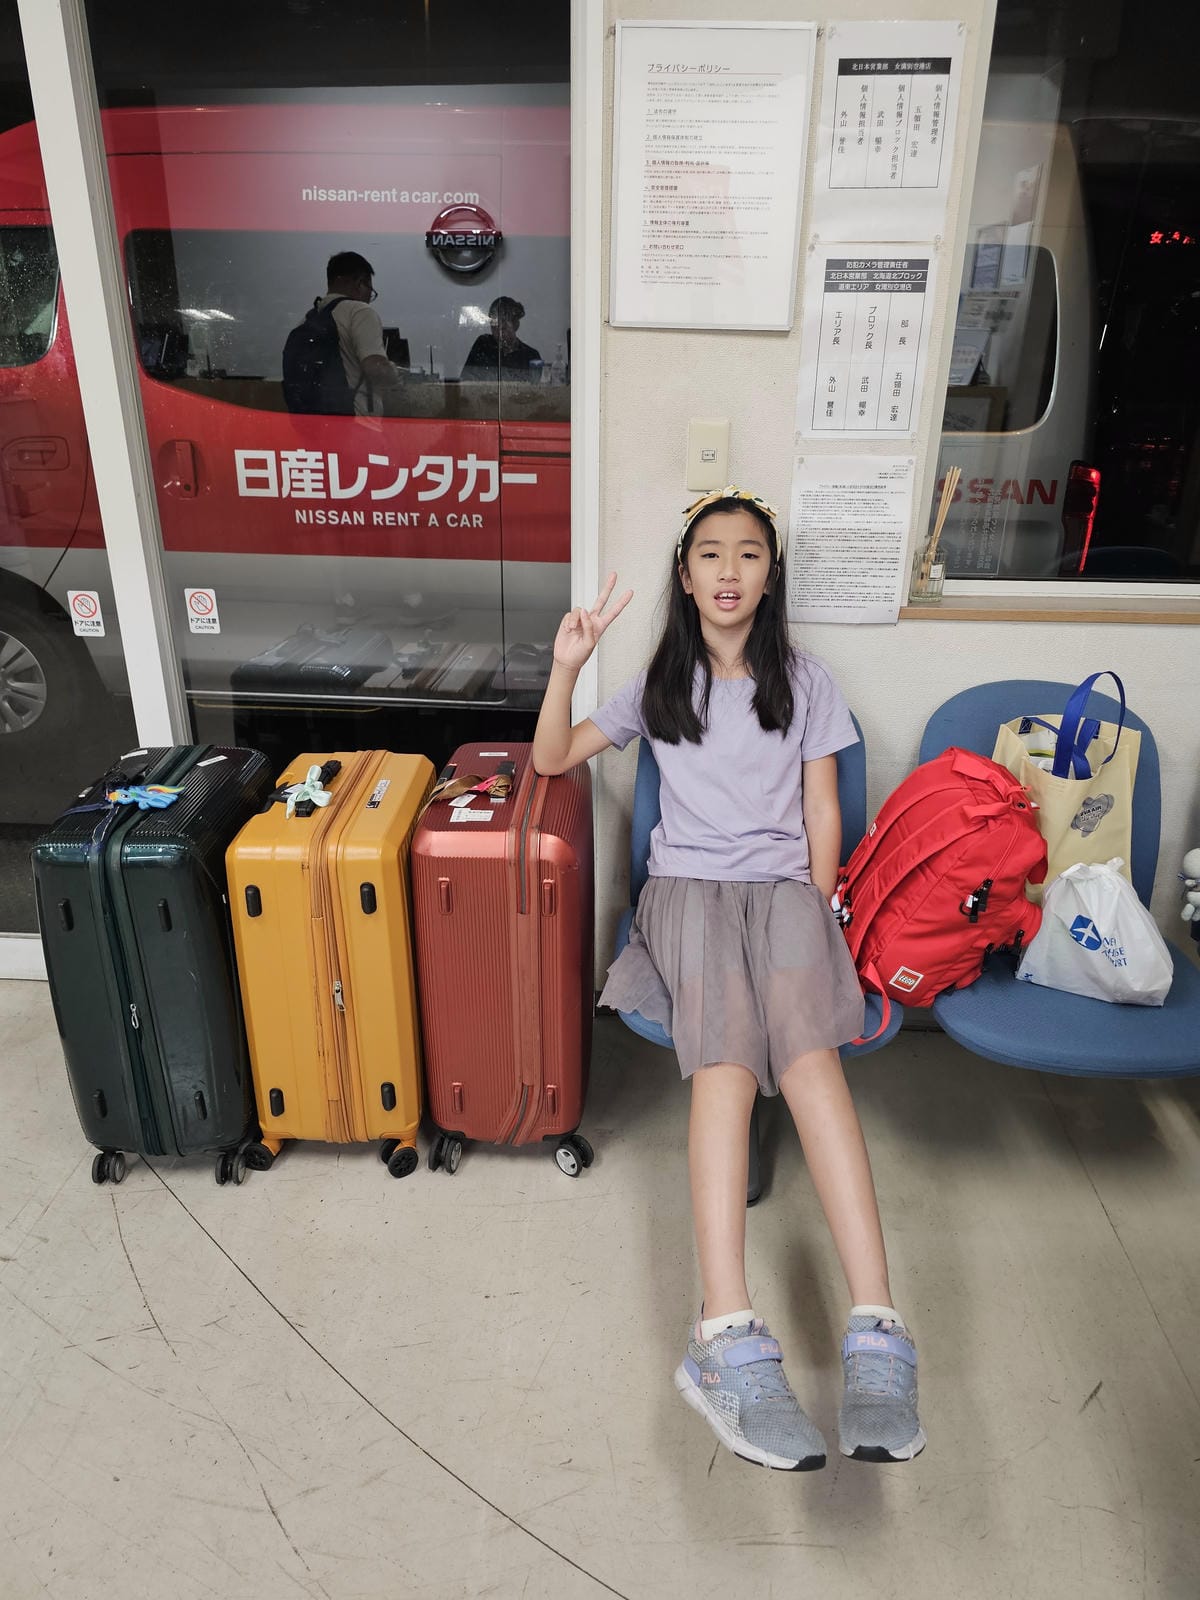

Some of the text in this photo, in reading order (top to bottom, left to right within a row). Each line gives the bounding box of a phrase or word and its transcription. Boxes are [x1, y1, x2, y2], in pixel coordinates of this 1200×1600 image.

[647, 63, 730, 73] プライバシーポリシー
[840, 110, 848, 127] 外山
[832, 311, 843, 345] エリア長
[865, 306, 877, 350] ブロック長
[828, 376, 837, 393] 外山
[860, 376, 869, 393] 武田
[234, 448, 538, 503] 日産レンタカー
[295, 509, 483, 528] NISSAN RENT A CAR
[857, 1335, 888, 1348] FILA
[702, 1371, 720, 1384] FILA
